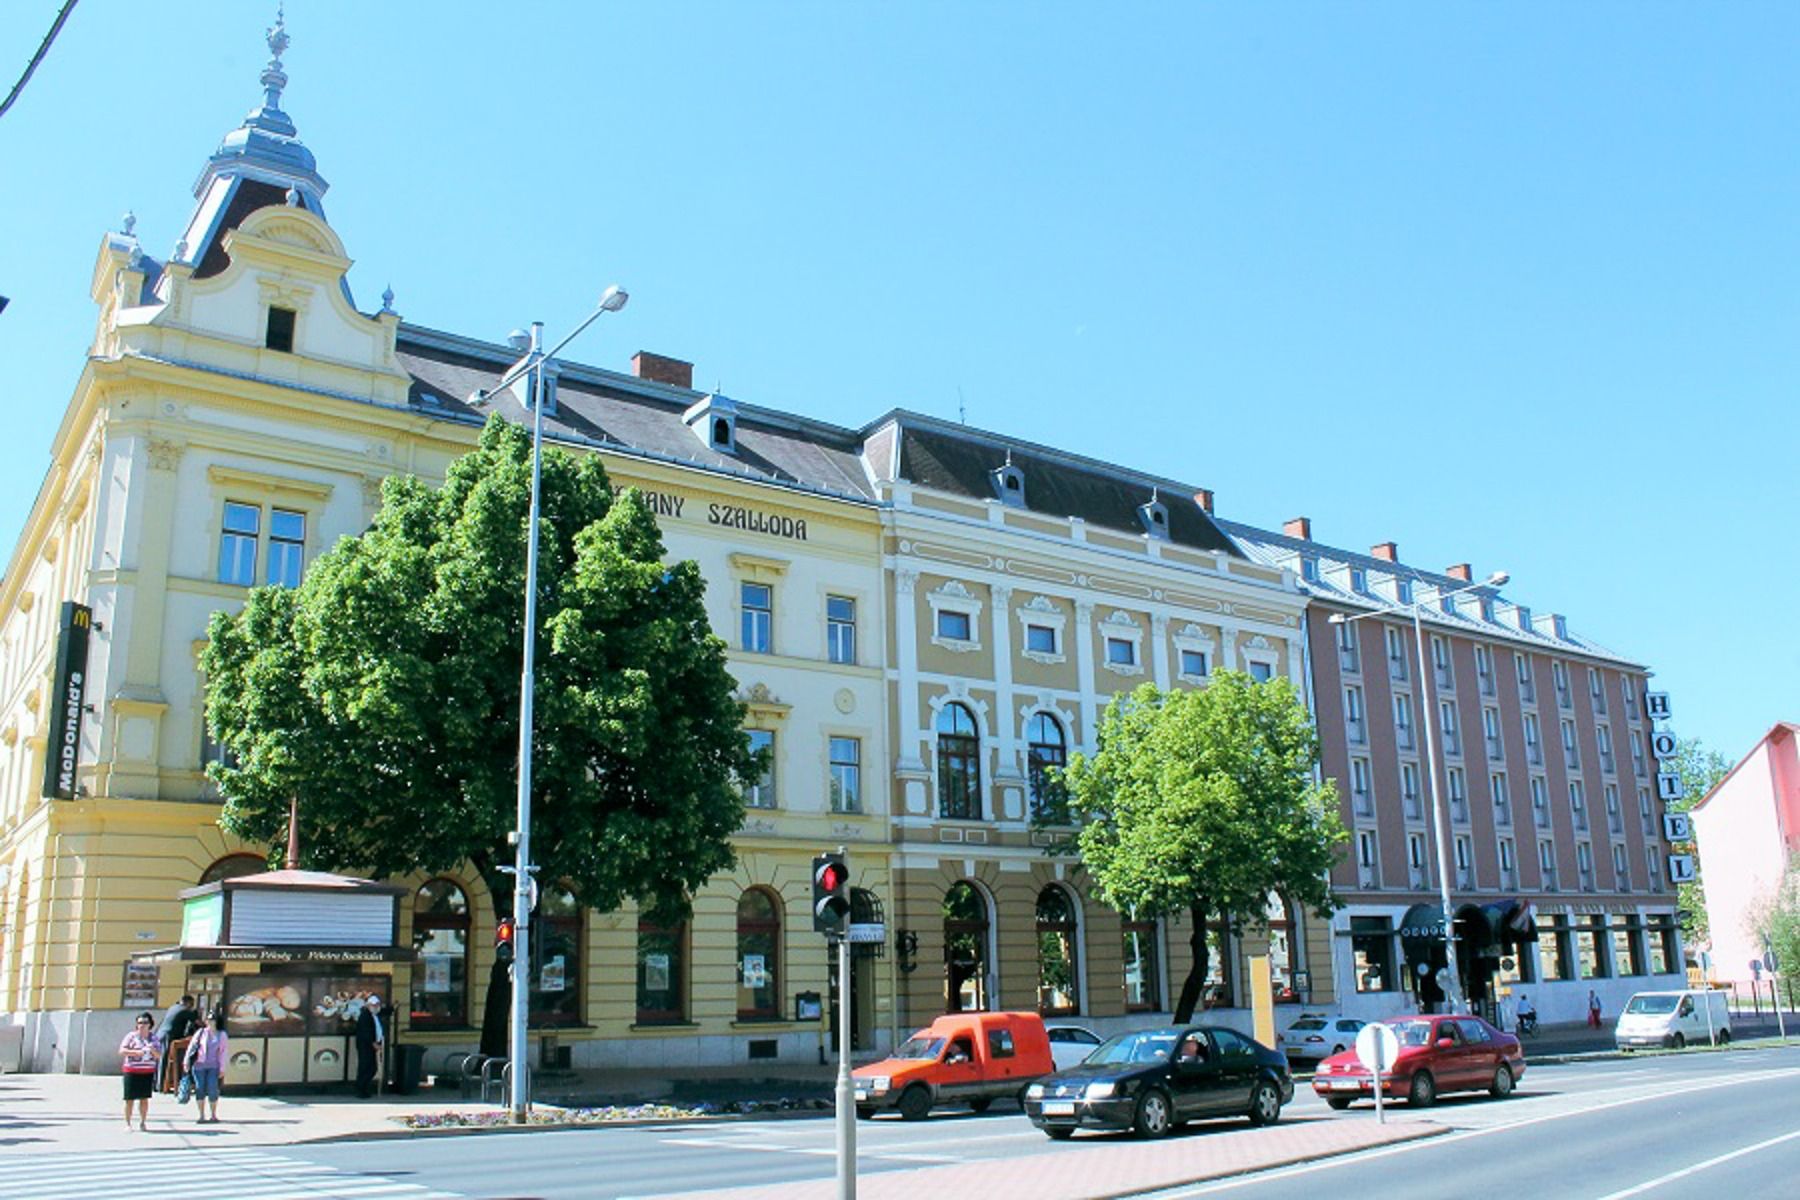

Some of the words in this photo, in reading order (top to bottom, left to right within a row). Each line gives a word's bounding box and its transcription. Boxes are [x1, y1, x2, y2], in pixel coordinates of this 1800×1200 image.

[708, 503, 807, 541] SZÁLLODA
[59, 671, 82, 791] McDonald's
[1649, 695, 1693, 880] HOTEL
